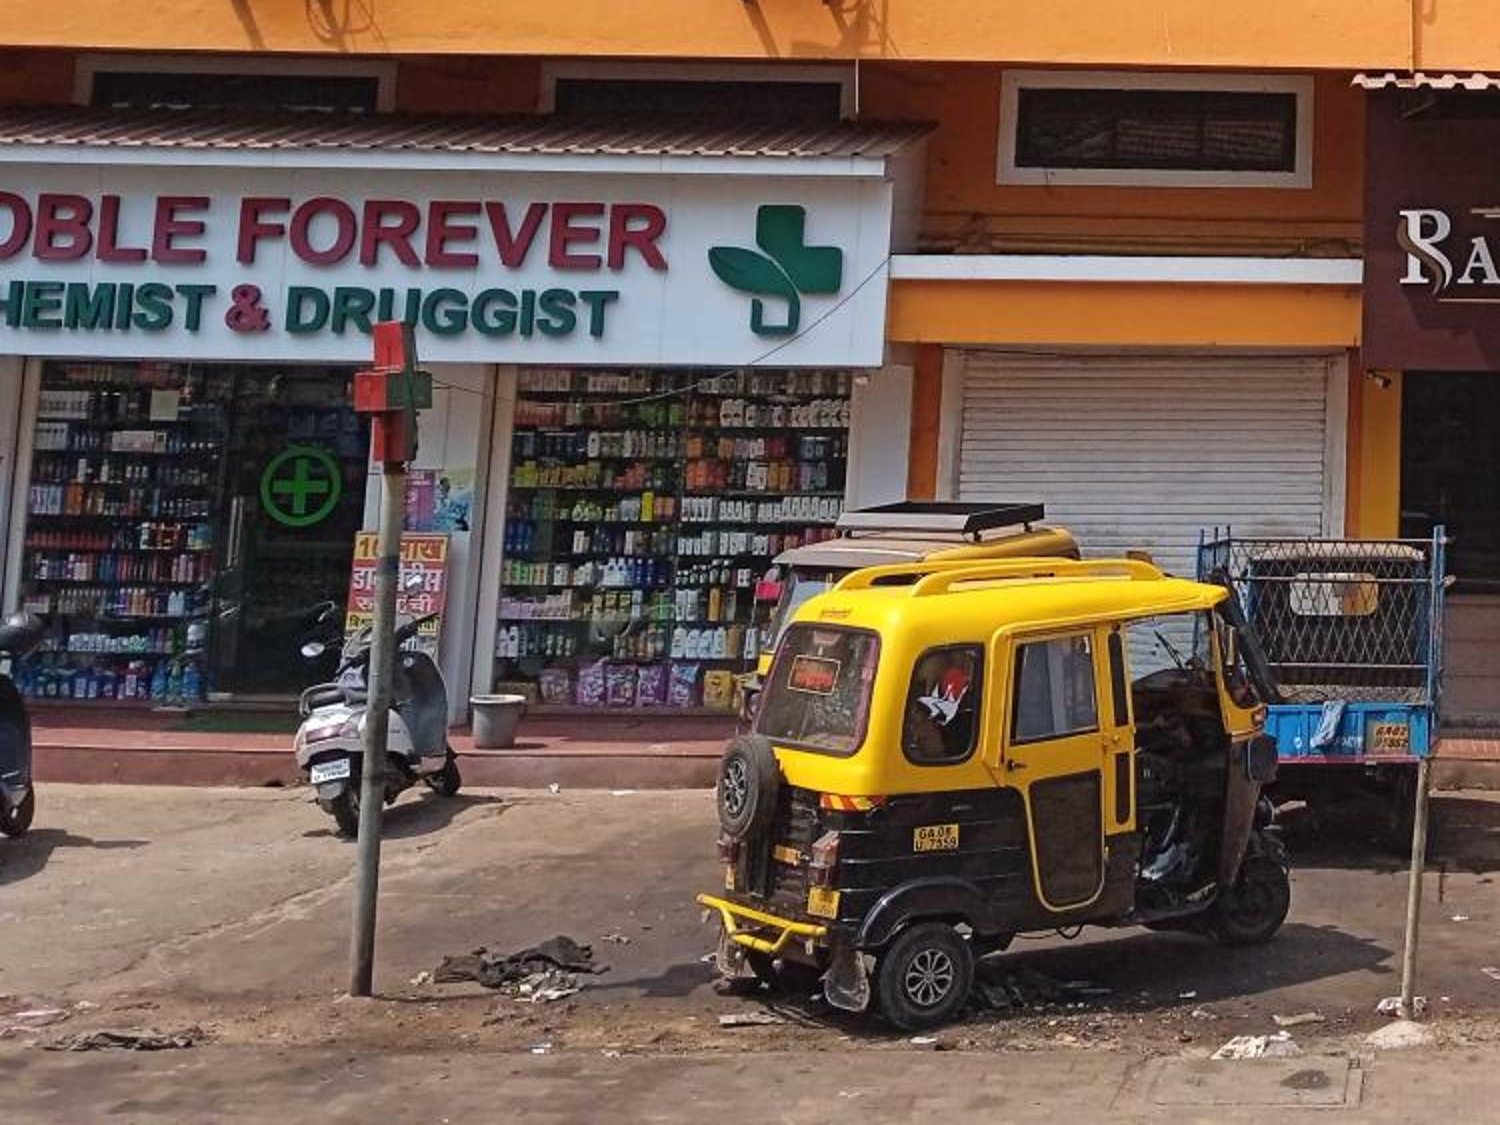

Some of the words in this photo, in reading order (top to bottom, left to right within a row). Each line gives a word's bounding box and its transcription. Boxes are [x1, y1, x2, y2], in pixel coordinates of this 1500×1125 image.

[236, 195, 669, 271] FOREVER
[224, 284, 271, 332] &
[285, 286, 619, 337] DRUGGIST
